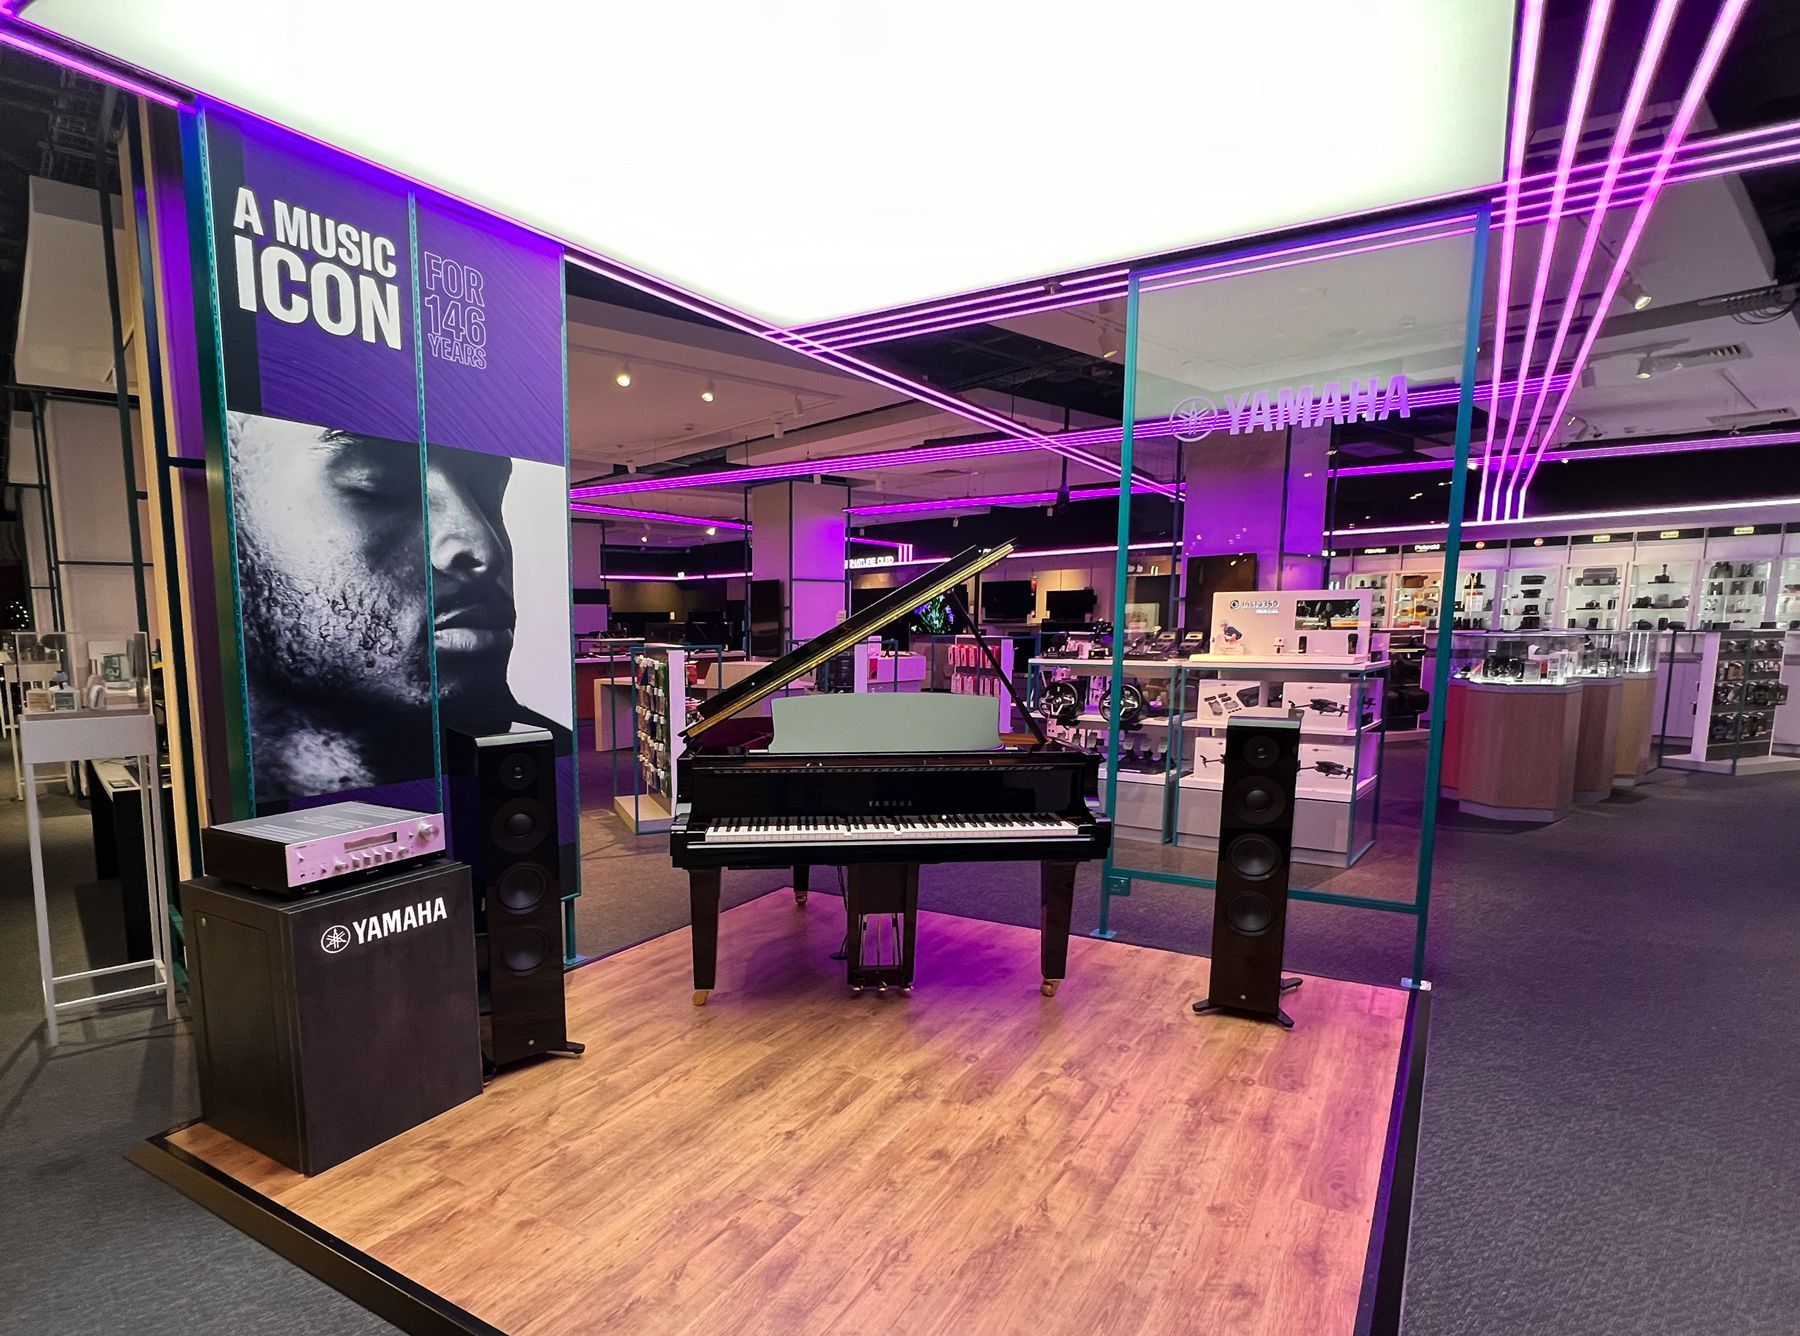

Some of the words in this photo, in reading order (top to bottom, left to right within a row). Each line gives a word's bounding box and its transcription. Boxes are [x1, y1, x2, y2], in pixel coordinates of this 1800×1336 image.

[233, 186, 264, 236] A
[273, 199, 397, 279] MUSIC
[233, 234, 402, 351] ICON
[424, 251, 485, 307] FOR
[425, 294, 486, 348] 146
[428, 333, 487, 369] YEARS
[1223, 372, 1411, 436] YAMAHA
[352, 896, 448, 945] YAMAHA
